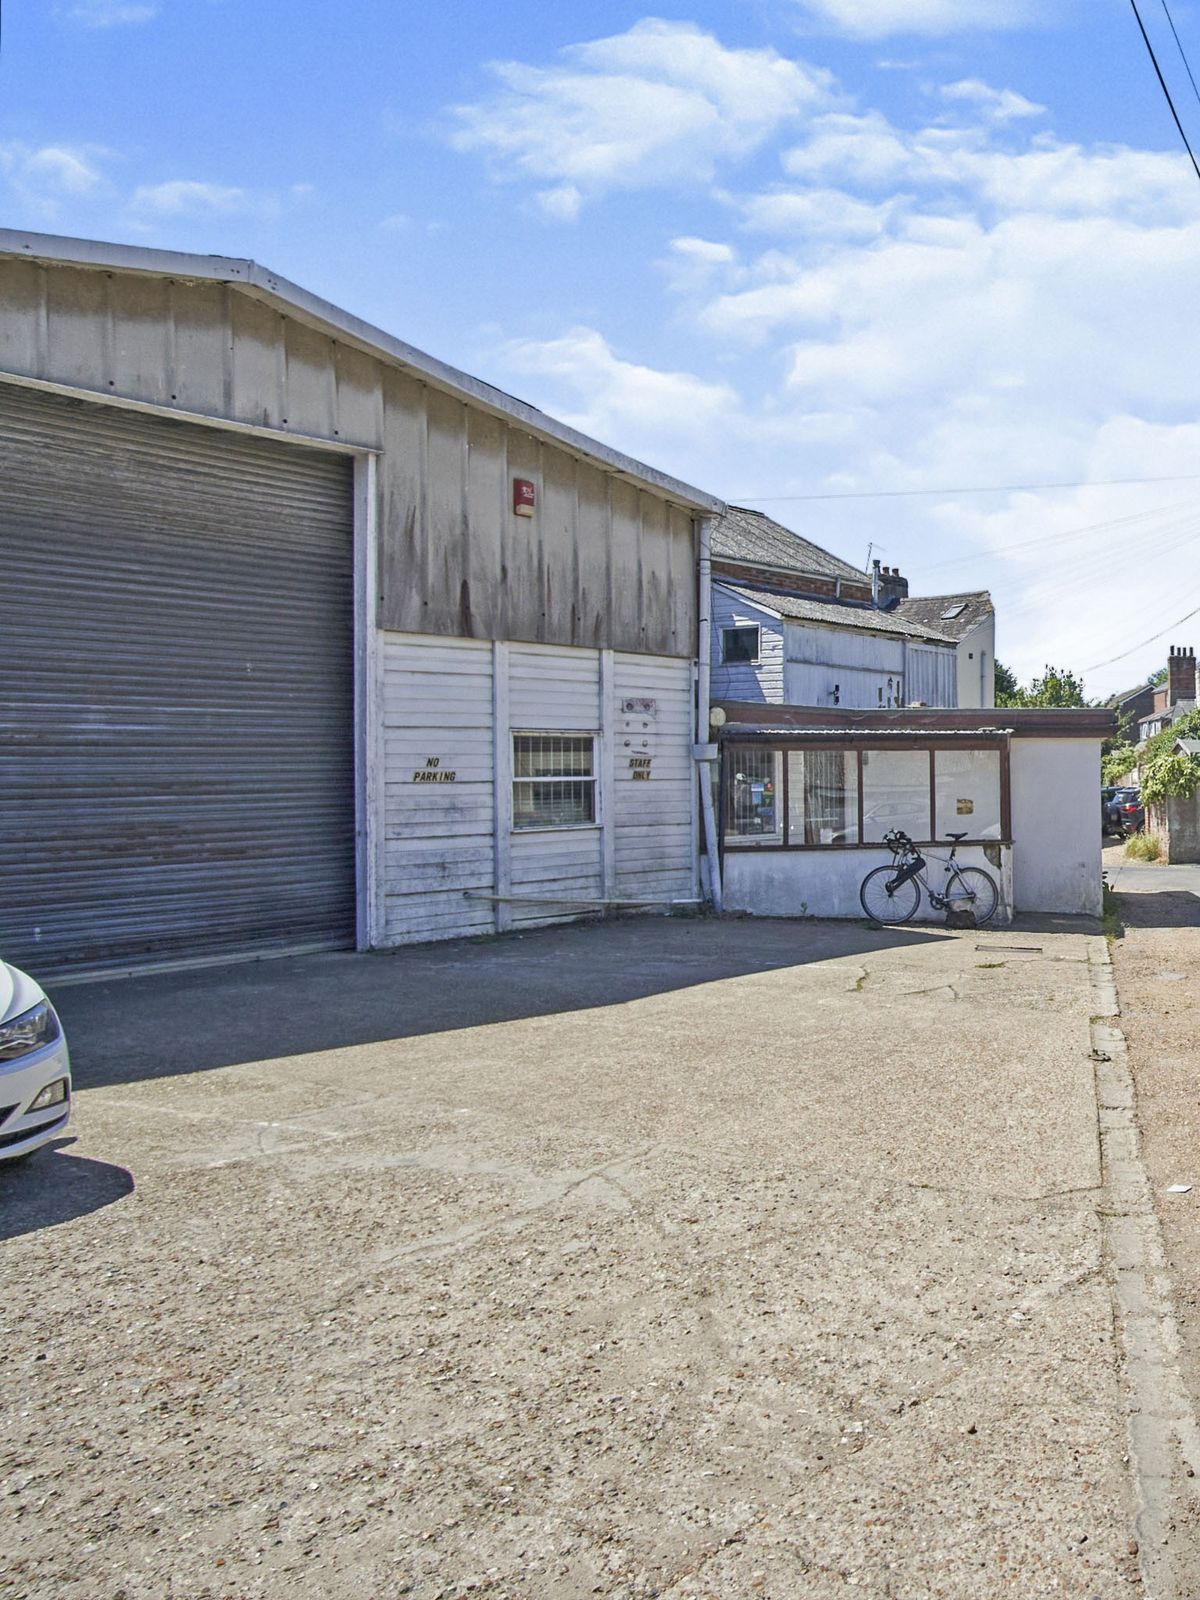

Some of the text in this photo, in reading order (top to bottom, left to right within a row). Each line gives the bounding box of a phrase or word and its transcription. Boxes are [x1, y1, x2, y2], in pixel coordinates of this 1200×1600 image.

[426, 757, 440, 768] NO
[629, 758, 652, 768] STAFF
[413, 771, 456, 782] PARKING
[632, 770, 651, 780] ONLY
